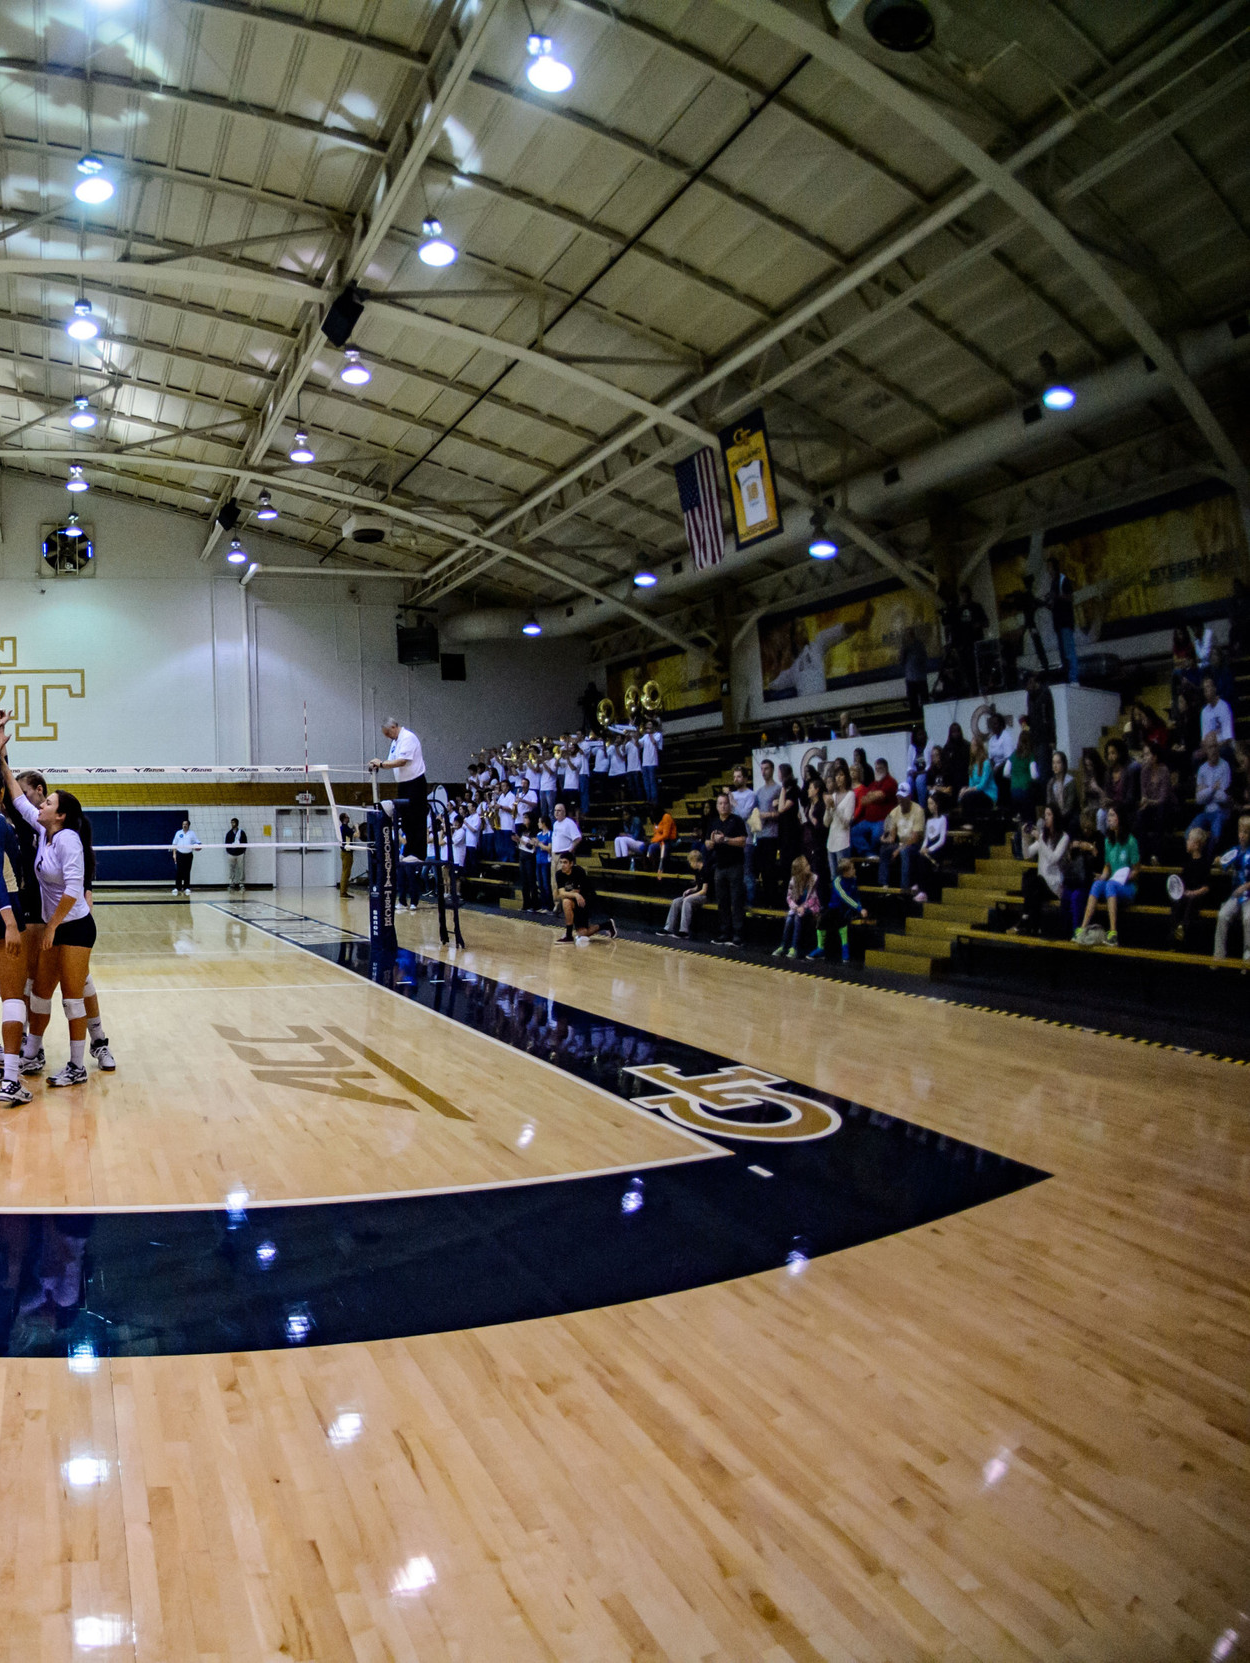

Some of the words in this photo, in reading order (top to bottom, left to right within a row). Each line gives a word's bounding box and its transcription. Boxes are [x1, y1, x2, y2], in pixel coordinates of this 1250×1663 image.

[382, 826, 392, 887] GEORGIA
[384, 890, 392, 926] TECH
[623, 1063, 843, 1142] GT
